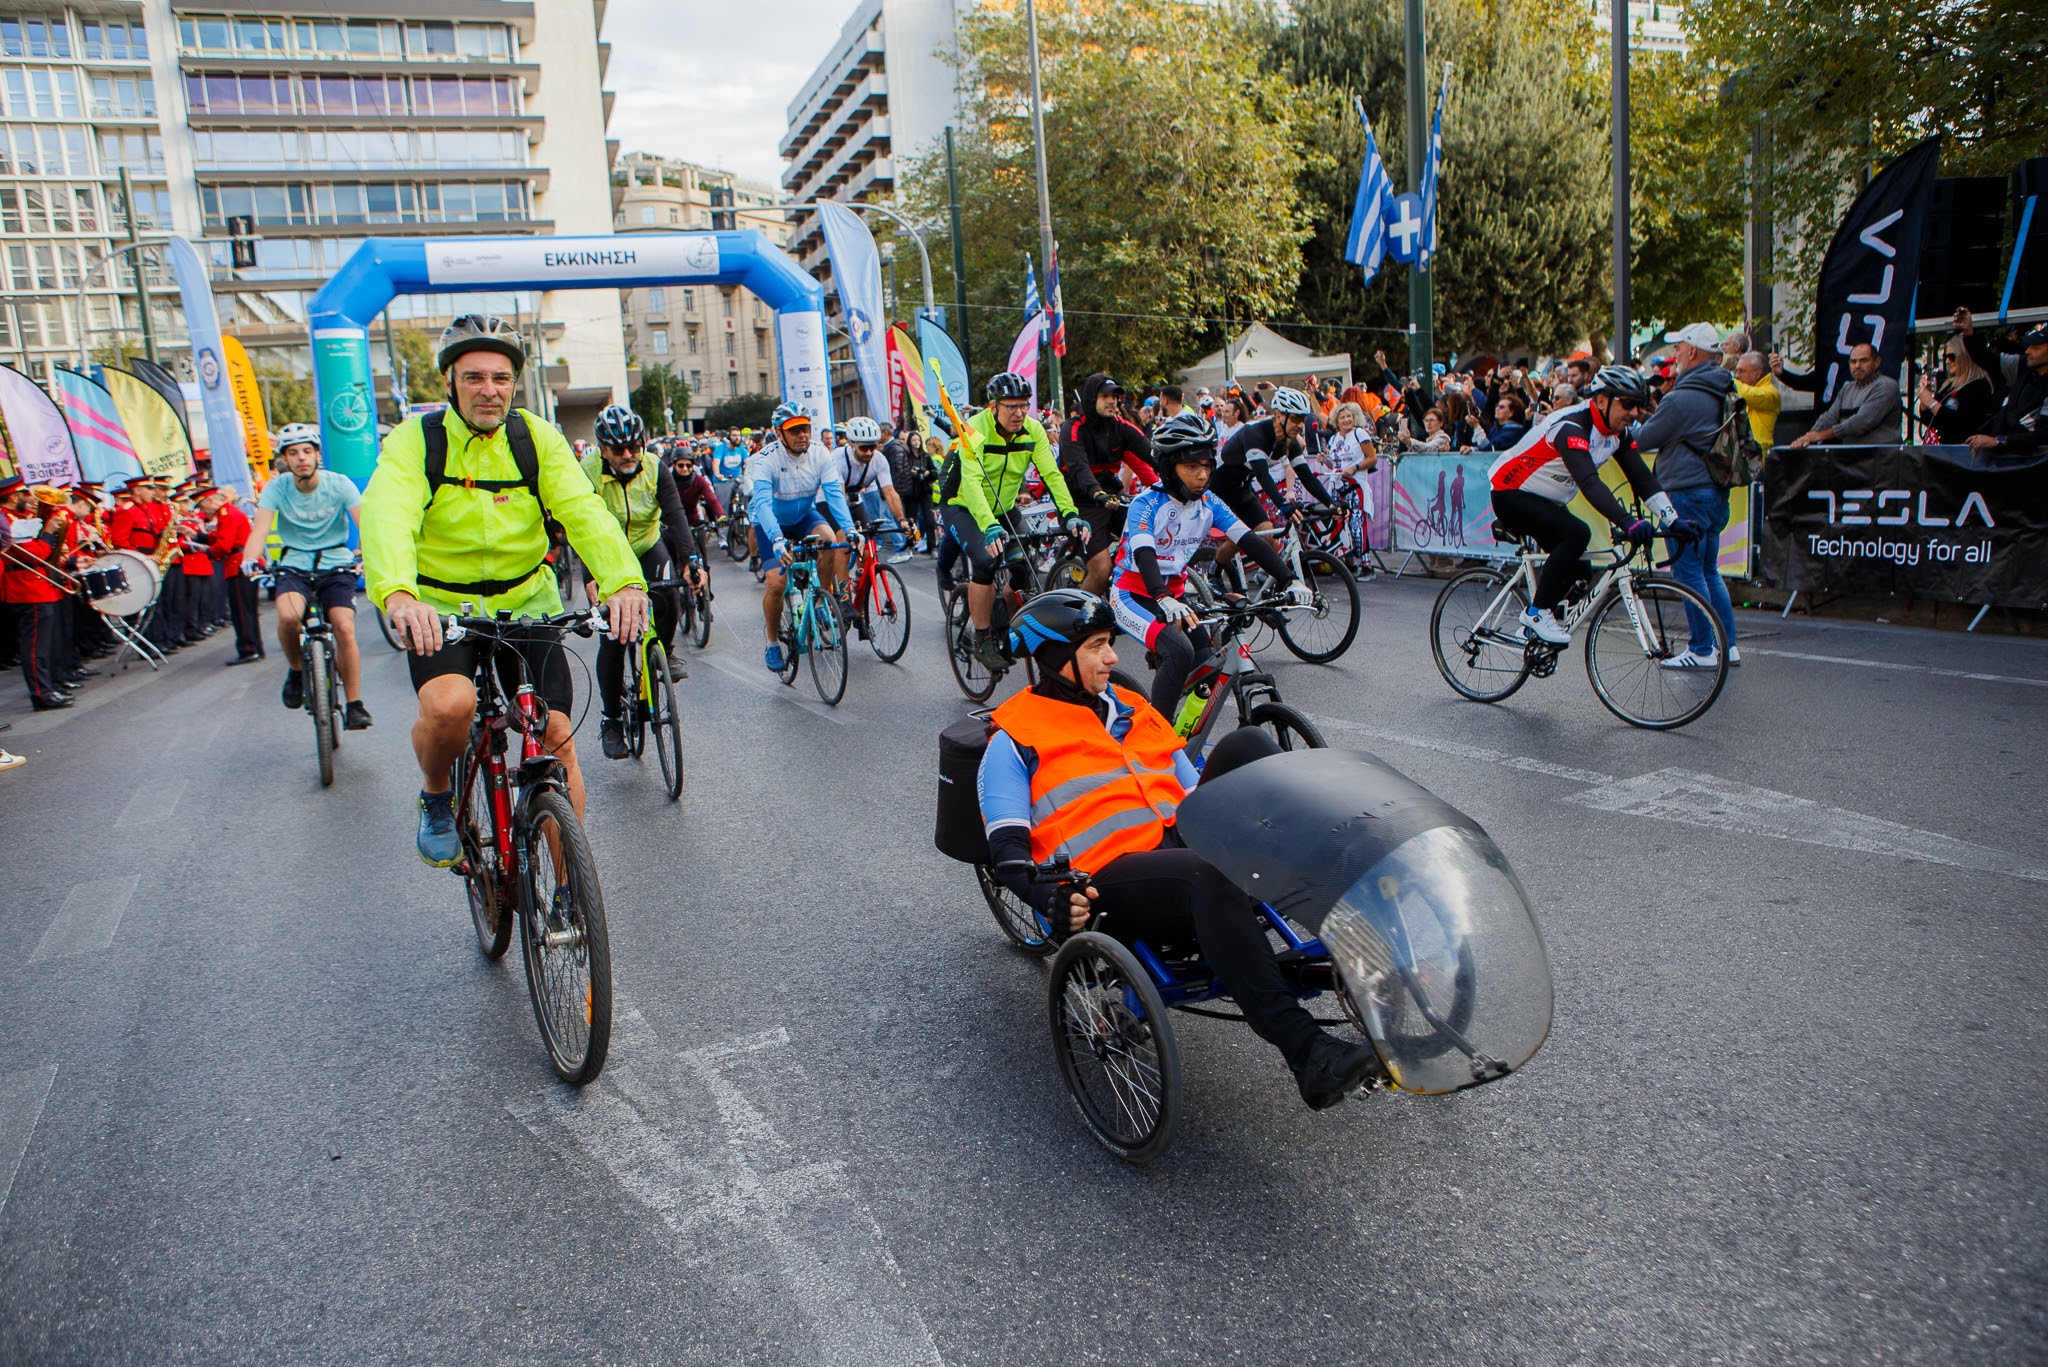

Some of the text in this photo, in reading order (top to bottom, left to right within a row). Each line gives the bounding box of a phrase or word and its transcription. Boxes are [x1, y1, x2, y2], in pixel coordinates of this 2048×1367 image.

[544, 250, 637, 267] ΕΚΚΙΝΗΣΗ
[1808, 490, 1995, 528] TESLA
[1808, 534, 1992, 566] Technology for all
